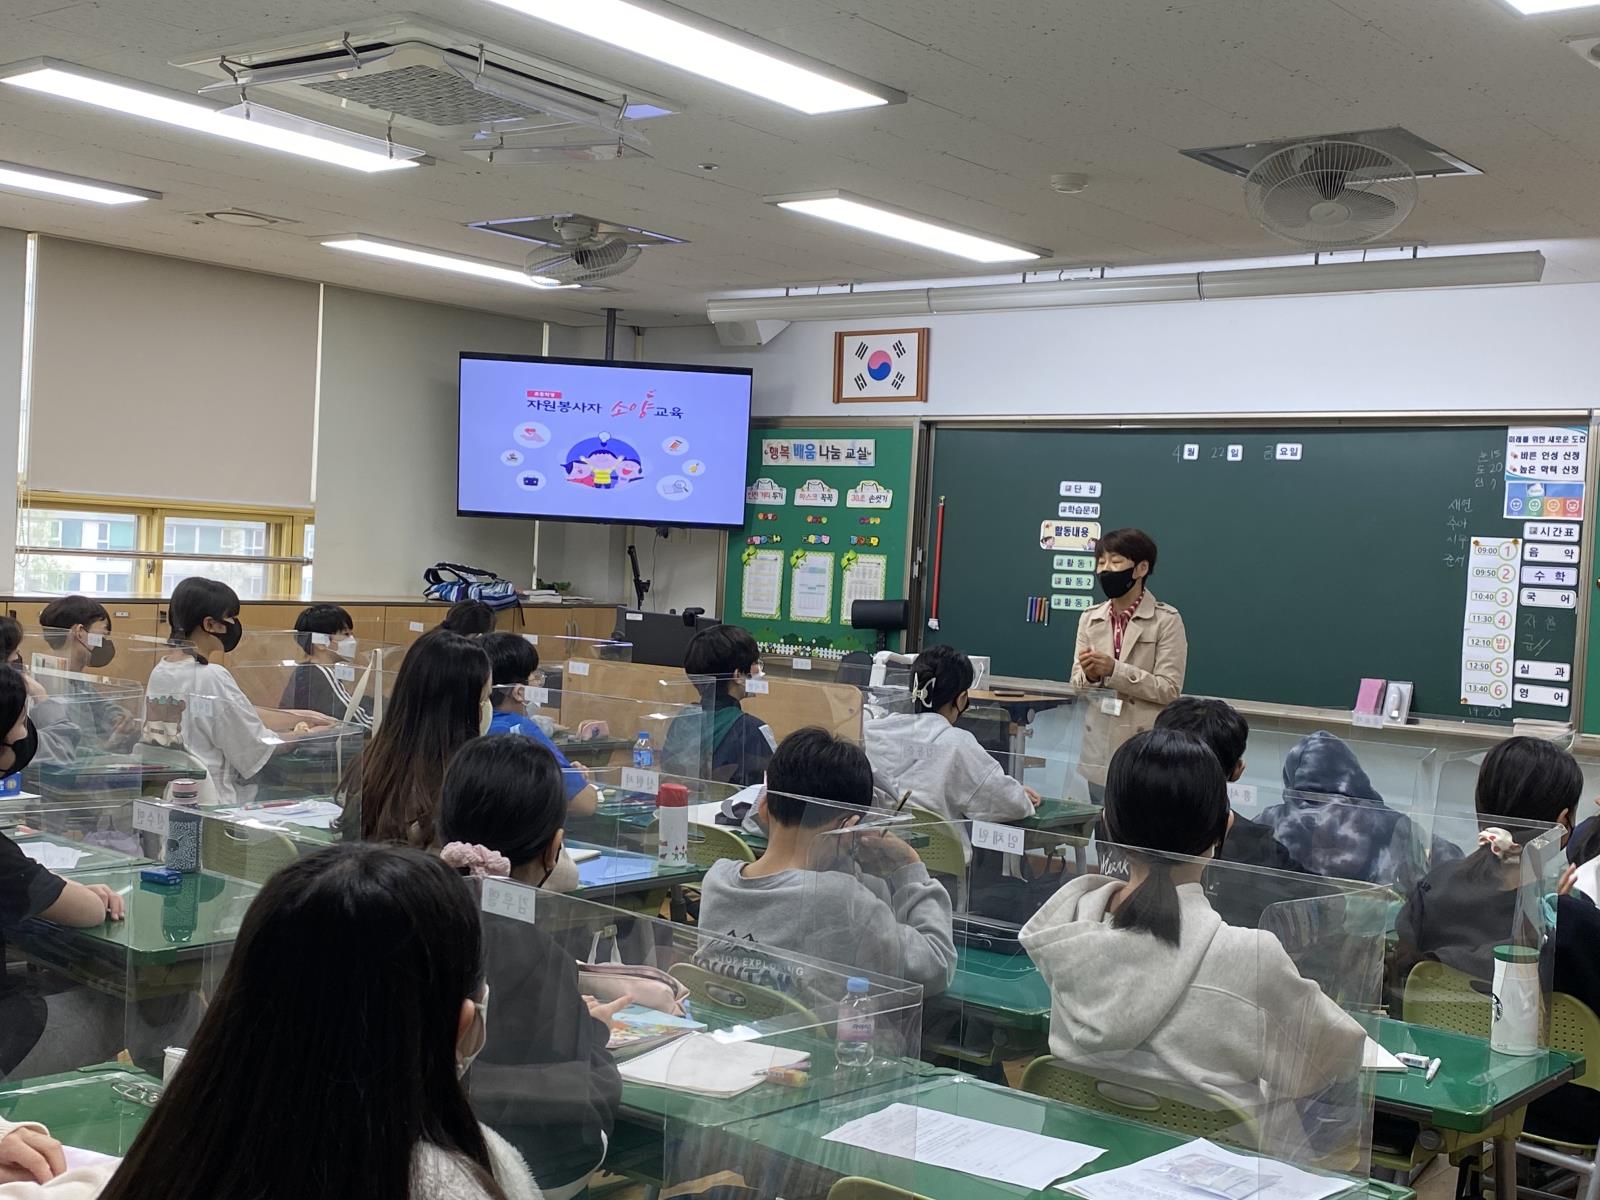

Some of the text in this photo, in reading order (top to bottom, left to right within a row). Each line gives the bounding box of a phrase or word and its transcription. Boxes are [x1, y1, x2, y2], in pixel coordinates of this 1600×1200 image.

[527, 399, 601, 414] 자원봉사자
[1548, 435, 1569, 444] 새로운
[769, 443, 868, 461] 행복 배움 나눔 교실
[1211, 446, 1225, 459] 22
[1231, 448, 1239, 458] 일
[1280, 446, 1298, 457] 요일
[1520, 451, 1580, 461] 바른 인성 신정
[1489, 462, 1504, 473] 20
[1520, 465, 1536, 474] 높은
[1562, 465, 1579, 475] 신정
[1068, 505, 1099, 515] 학습문제
[1055, 525, 1089, 538] 활동내용
[1540, 526, 1574, 537] 시간표
[1477, 546, 1510, 557] 09:00 1
[1475, 568, 1510, 580] 09:50 2
[1474, 591, 1508, 604] 10:40 3
[1472, 615, 1506, 627] 11:30 4
[1471, 637, 1507, 650] 12:10 밥
[1469, 661, 1503, 674] 12:50 5
[1468, 684, 1502, 697] 13:40 6
